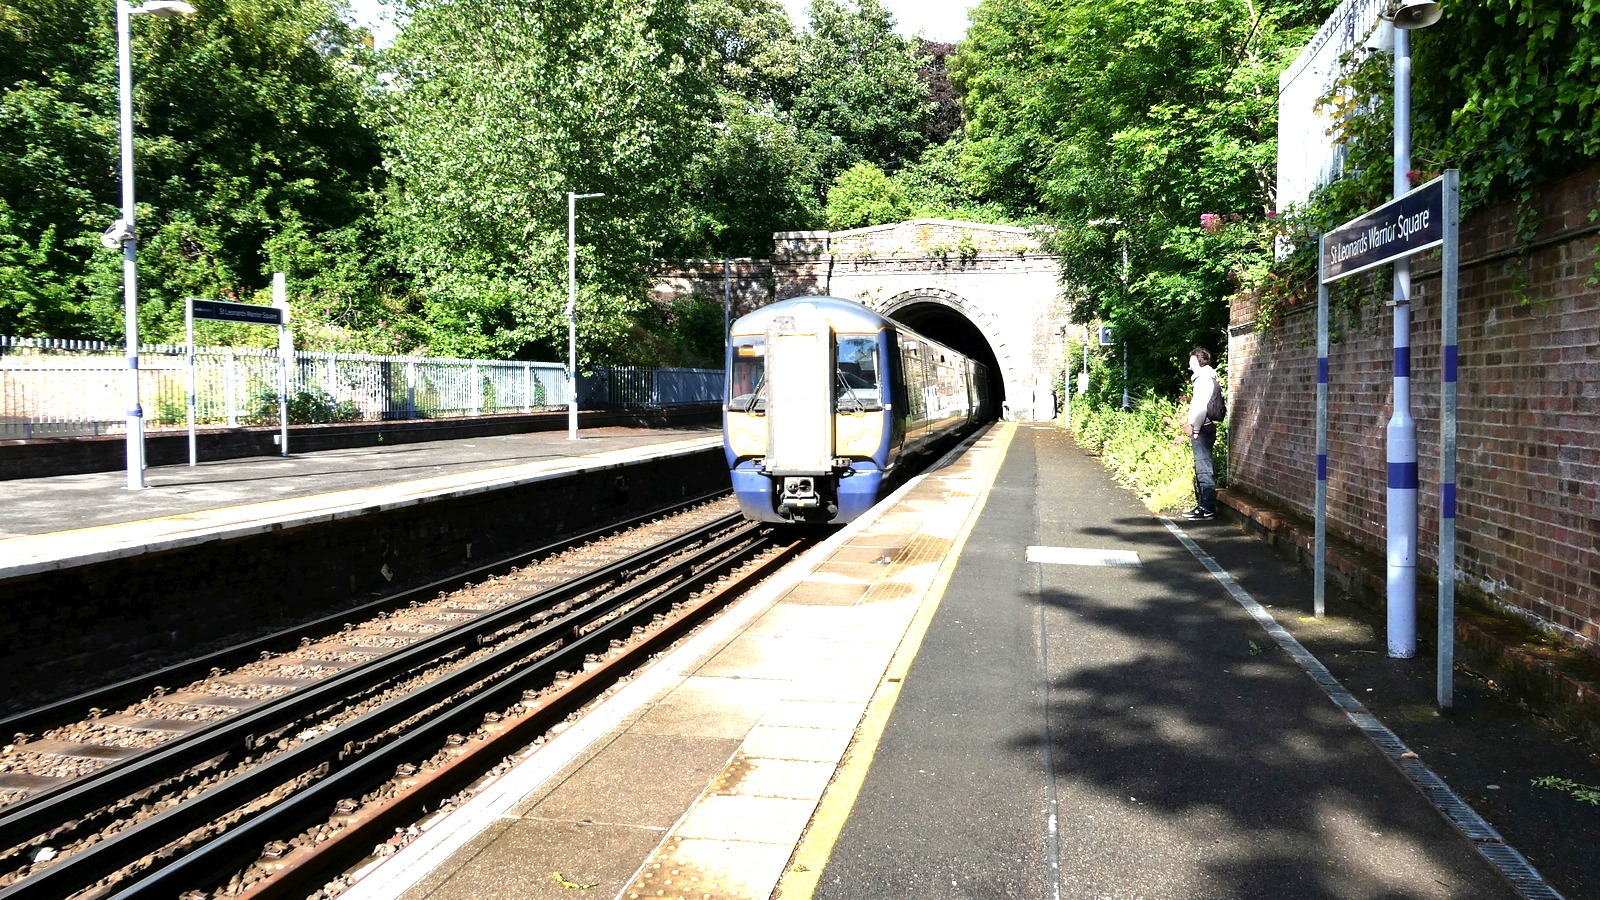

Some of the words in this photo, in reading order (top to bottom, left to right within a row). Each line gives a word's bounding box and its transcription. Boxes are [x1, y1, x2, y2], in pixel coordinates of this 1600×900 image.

[1330, 245, 1337, 265] St
[1338, 232, 1368, 261] Leonards
[1368, 221, 1397, 250] Warrior
[1397, 208, 1430, 242] Square
[219, 307, 225, 315] St
[262, 311, 277, 320] Square
